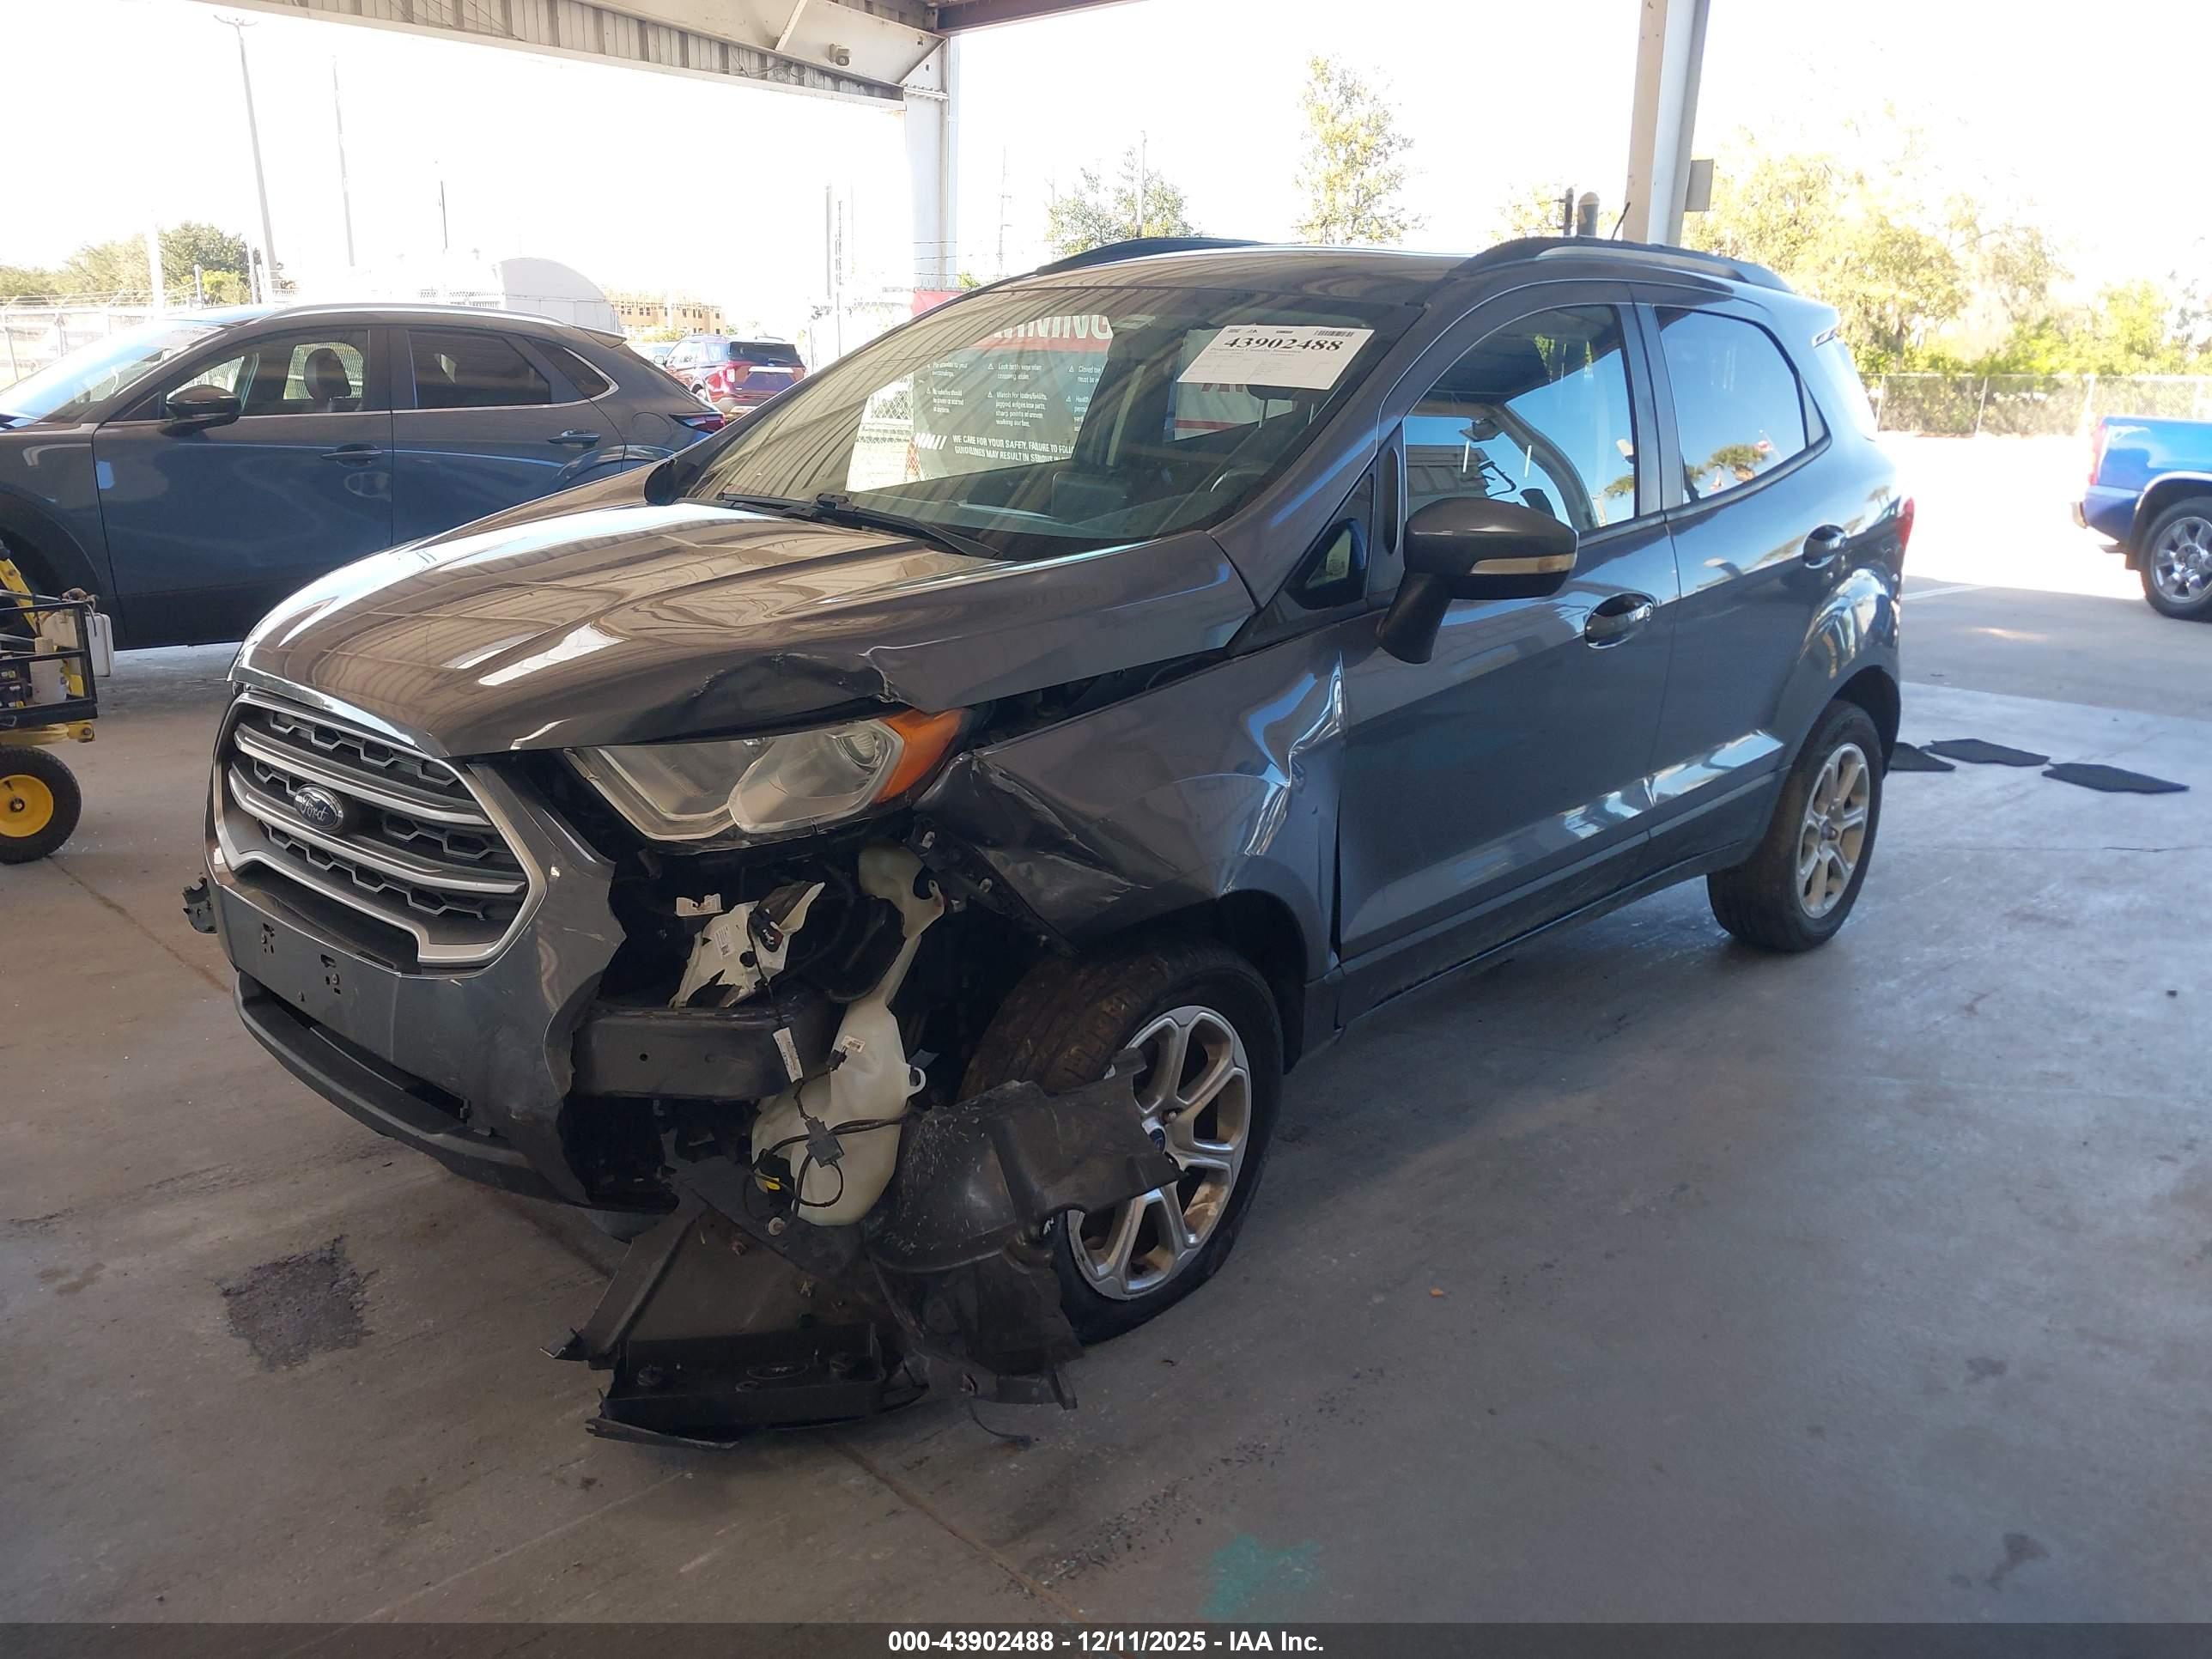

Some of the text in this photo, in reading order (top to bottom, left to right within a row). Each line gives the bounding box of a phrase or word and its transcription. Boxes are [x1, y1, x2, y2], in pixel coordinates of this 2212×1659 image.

[1224, 337, 1344, 351] 43902488
[952, 434, 962, 443] WE
[963, 435, 976, 445] CARE
[976, 436, 987, 447] FOR
[988, 438, 1004, 448] YOUR
[1005, 440, 1028, 450] SAFETY.
[1029, 441, 1050, 453] FAILURE
[1050, 444, 1058, 453] TO
[986, 449, 1000, 459] MAY
[1000, 451, 1022, 461] RESULT
[1022, 453, 1029, 462] IN
[301, 793, 329, 822] Ford
